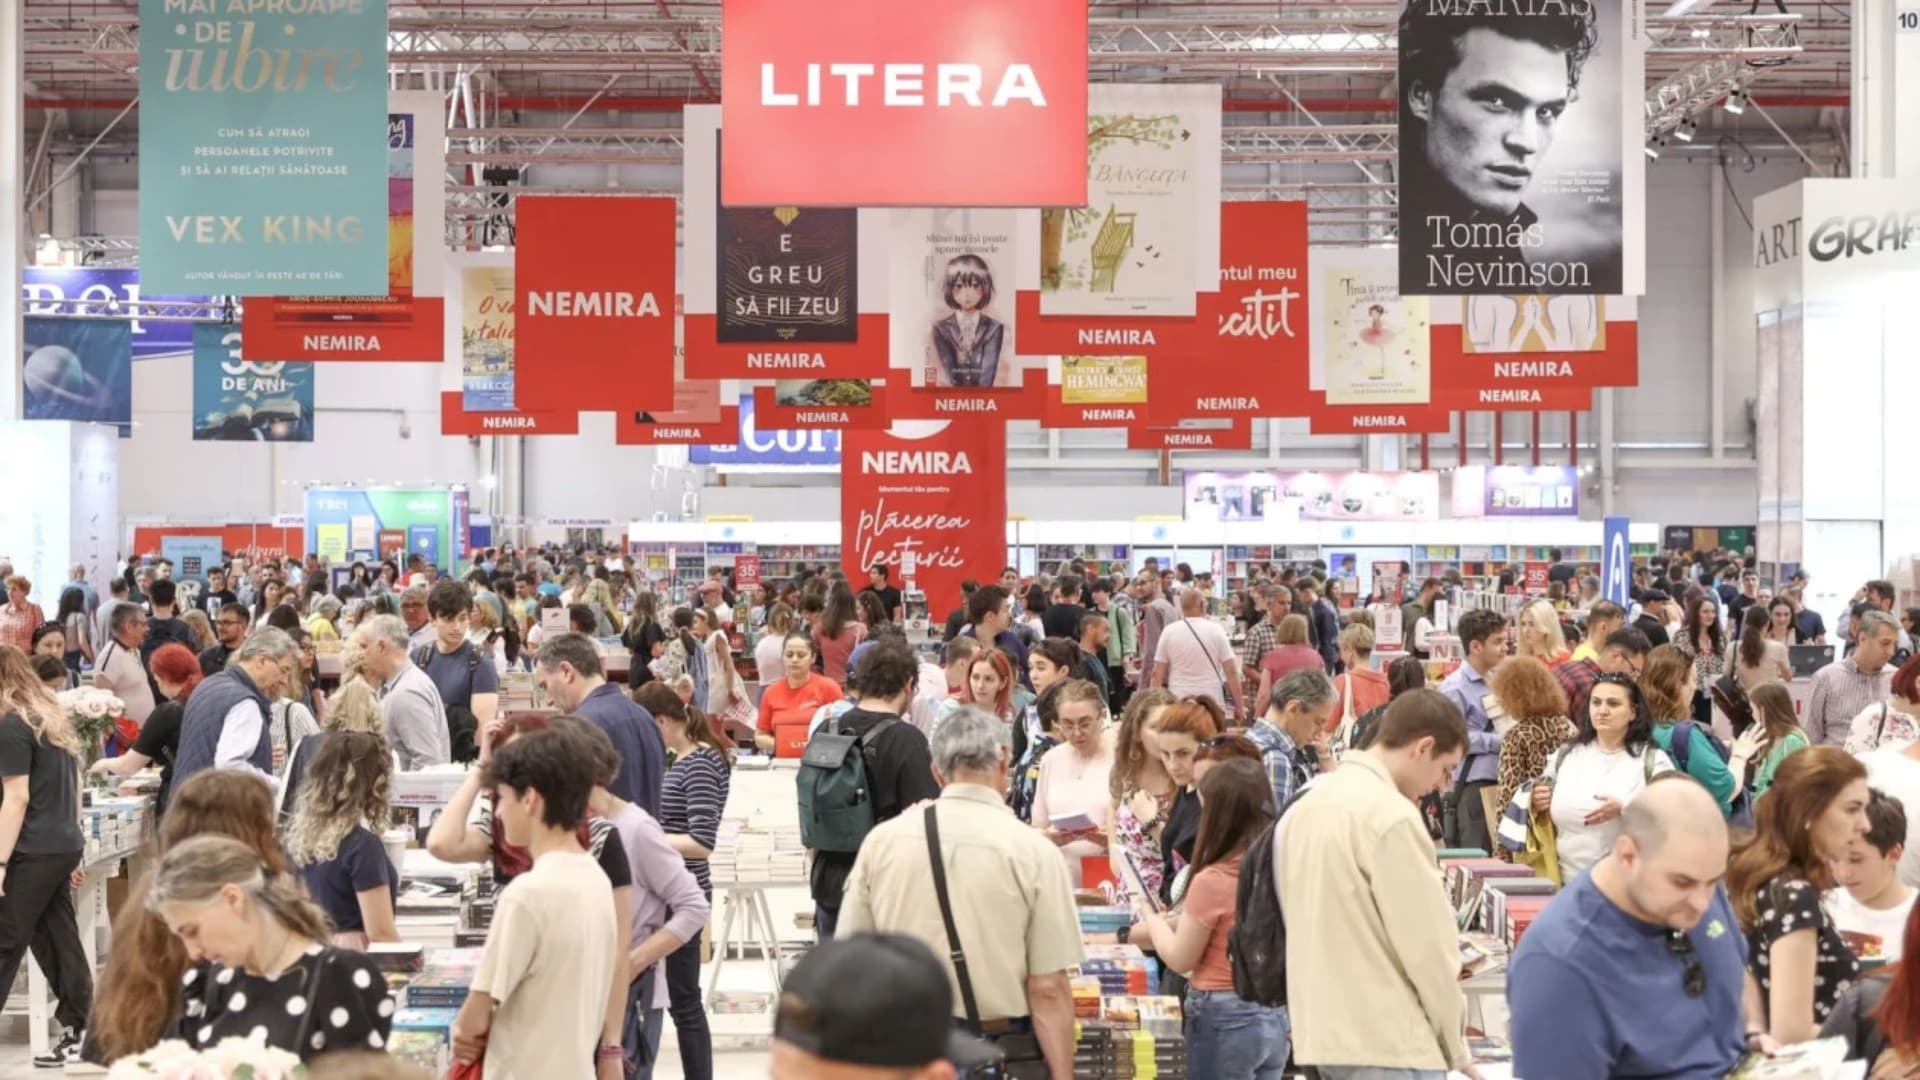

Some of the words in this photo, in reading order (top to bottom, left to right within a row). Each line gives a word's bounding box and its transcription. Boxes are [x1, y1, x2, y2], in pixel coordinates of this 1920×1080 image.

[164, 0, 217, 14] MAI
[226, 0, 364, 15] APROAPE
[1898, 12, 1919, 29] 10
[195, 21, 232, 42] DE
[165, 21, 365, 92] iubire
[760, 63, 1048, 107] LITERA
[218, 128, 244, 137] CUM
[195, 146, 270, 156] PERSOANELE
[273, 146, 334, 156] POTRIVITE
[215, 166, 227, 175] AI
[165, 215, 244, 243] VEX
[263, 215, 365, 243] KING
[1426, 214, 1544, 248] Tomás
[780, 234, 792, 252] E
[1755, 217, 1803, 268] ART
[748, 265, 823, 284] GREU
[1258, 267, 1298, 280] meu
[1426, 254, 1592, 287] Nevinson
[527, 291, 662, 317] NEMIRA
[767, 297, 791, 315] FII
[798, 297, 840, 315] ZEU
[303, 335, 381, 351] NEMIRA
[1078, 329, 1156, 345] NEMIRA
[747, 352, 826, 369] NEMIRA
[1494, 361, 1573, 378] NEMIRA
[222, 378, 247, 391] DE
[251, 378, 287, 391] ANI
[1067, 374, 1147, 389] HEMINGWA
[1196, 397, 1259, 410] NEMIRA
[1479, 389, 1543, 403] NEMIRA
[935, 399, 998, 411] NEMIRA
[483, 417, 536, 428] NEMIRA
[796, 412, 849, 423] NEMIRA
[1082, 409, 1136, 420] NEMIRA
[1353, 416, 1406, 427] NEMIRA
[653, 428, 701, 439] NEMIRA
[1164, 434, 1213, 445] NEMIRA
[861, 450, 972, 474] NEMIRA
